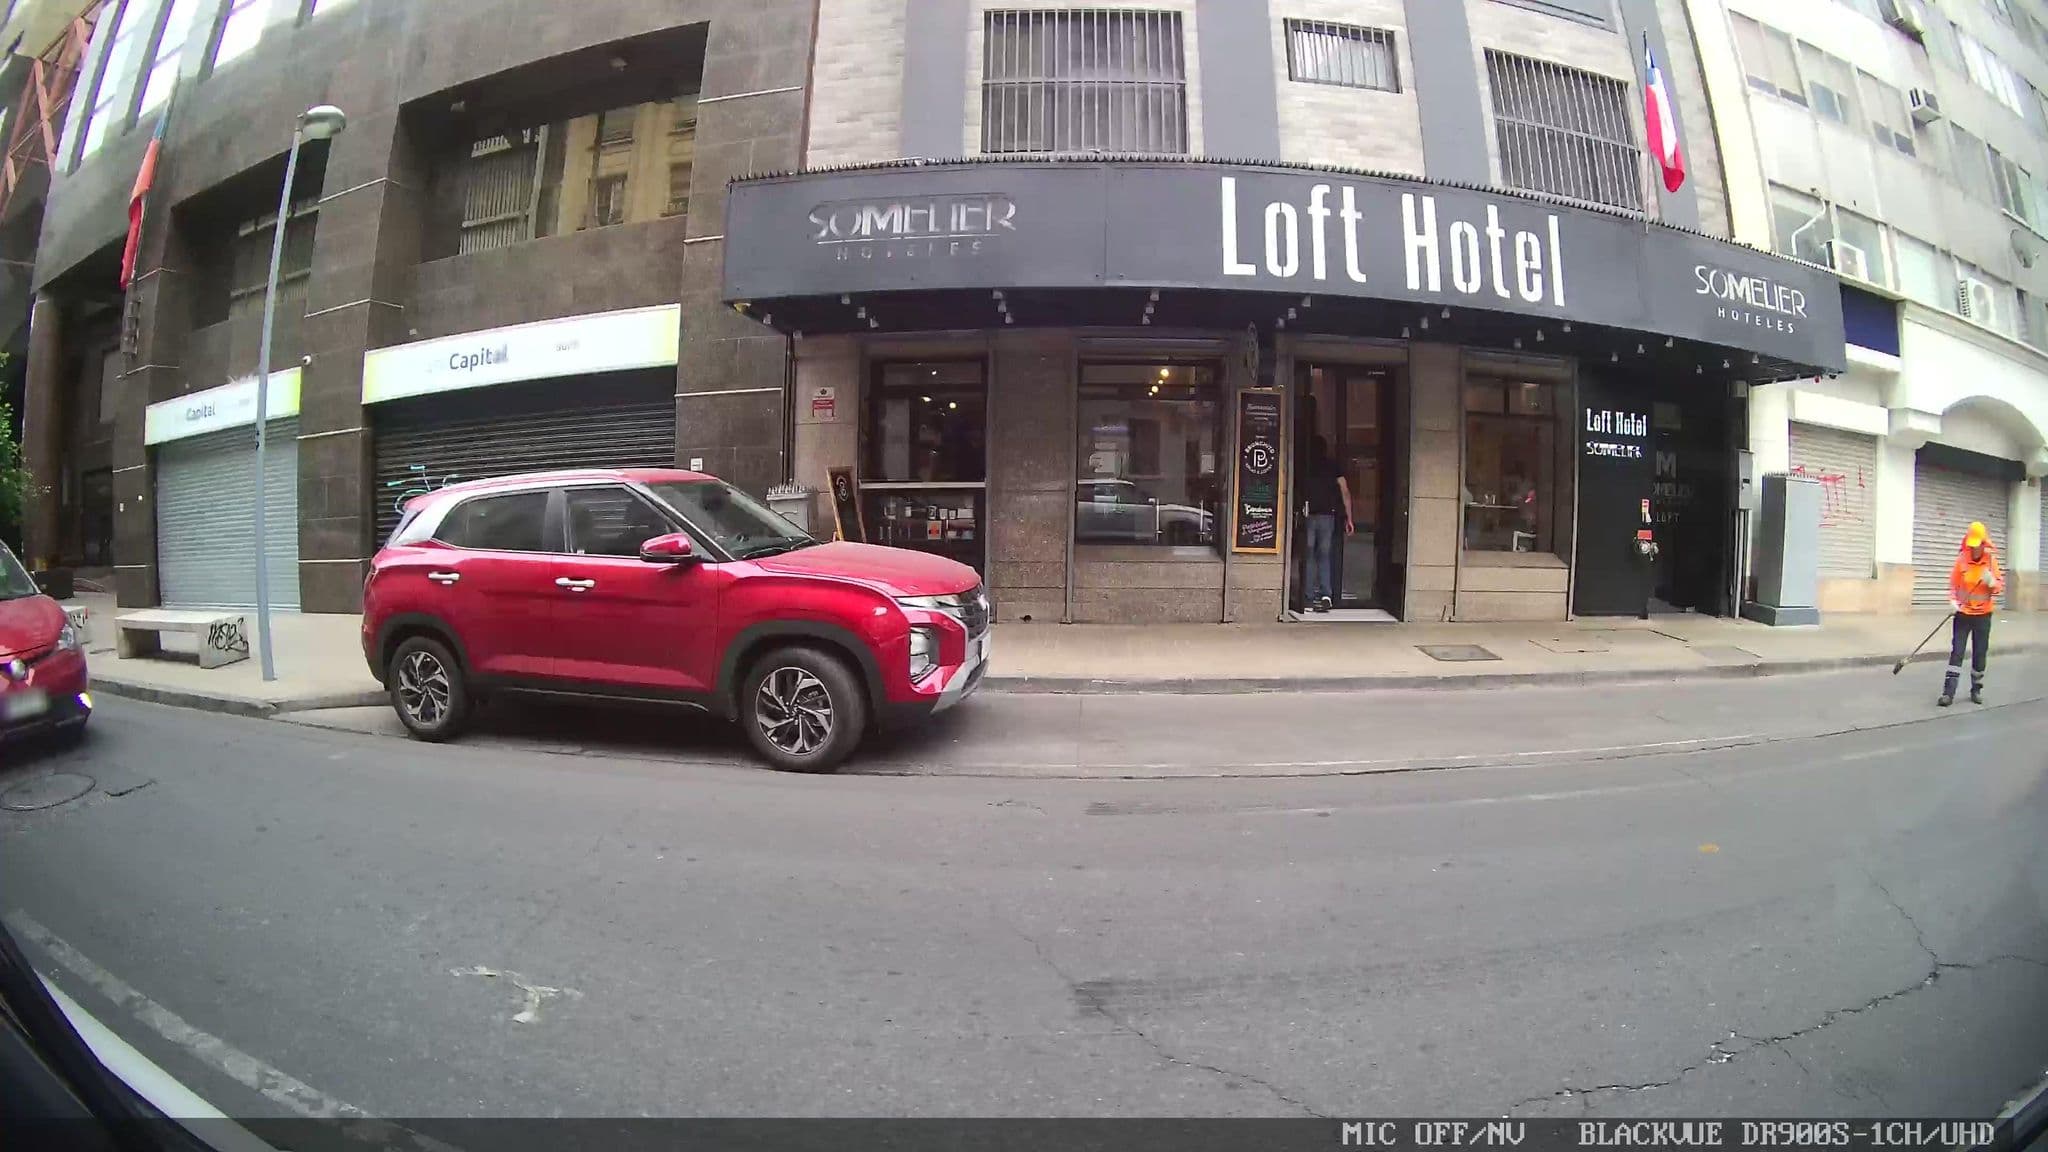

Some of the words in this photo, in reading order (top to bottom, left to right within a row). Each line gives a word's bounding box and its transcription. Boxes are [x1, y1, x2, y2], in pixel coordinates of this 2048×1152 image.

[809, 201, 1016, 239] SOMELIER
[1221, 176, 1367, 283] Loft
[1401, 193, 1565, 307] Hotel
[1694, 265, 1807, 319] SOMELIER
[1717, 306, 1794, 334] HOTELES
[449, 343, 508, 372] Capital
[1586, 407, 1612, 434] Loft
[1615, 411, 1647, 436] Hotel
